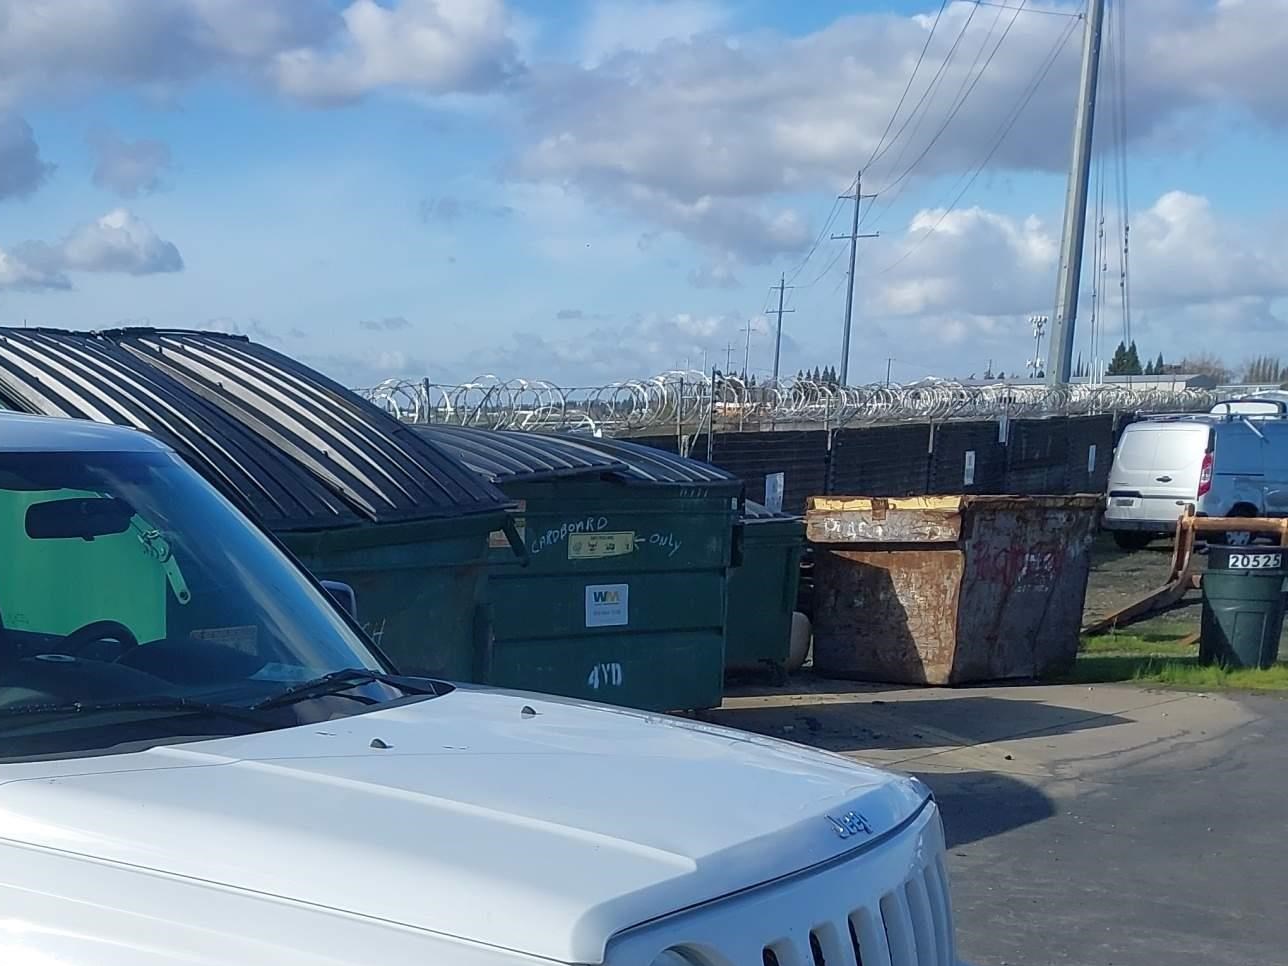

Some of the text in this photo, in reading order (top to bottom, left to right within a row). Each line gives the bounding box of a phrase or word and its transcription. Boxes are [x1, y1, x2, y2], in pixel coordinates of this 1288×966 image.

[532, 516, 608, 553] CARDBOARD
[1230, 554, 1281, 568] 20525
[593, 591, 621, 603] WM
[824, 811, 873, 840] Jeep
